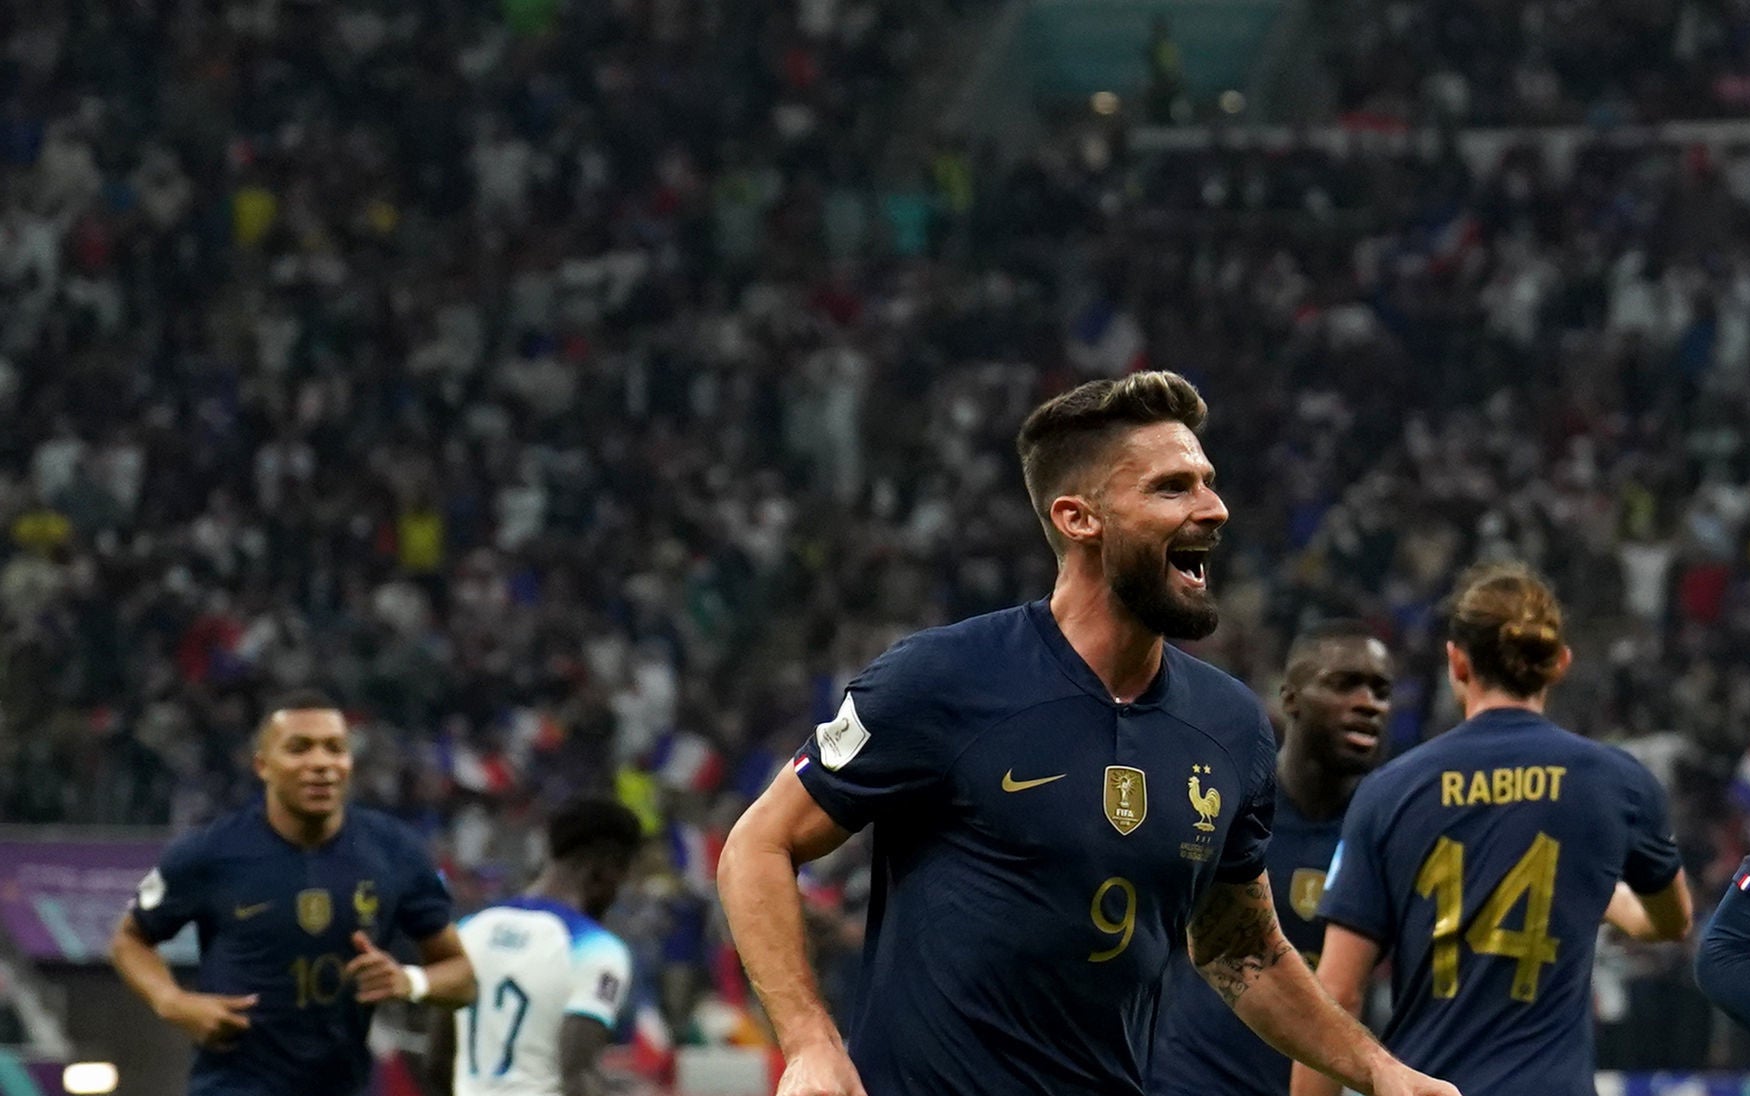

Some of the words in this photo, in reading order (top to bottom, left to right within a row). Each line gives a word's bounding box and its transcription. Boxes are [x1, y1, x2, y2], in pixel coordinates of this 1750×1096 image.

[1442, 765, 1567, 807] RABIOT
[1087, 876, 1137, 963] 9
[1415, 830, 1561, 1002] 14
[290, 953, 348, 1009] 10
